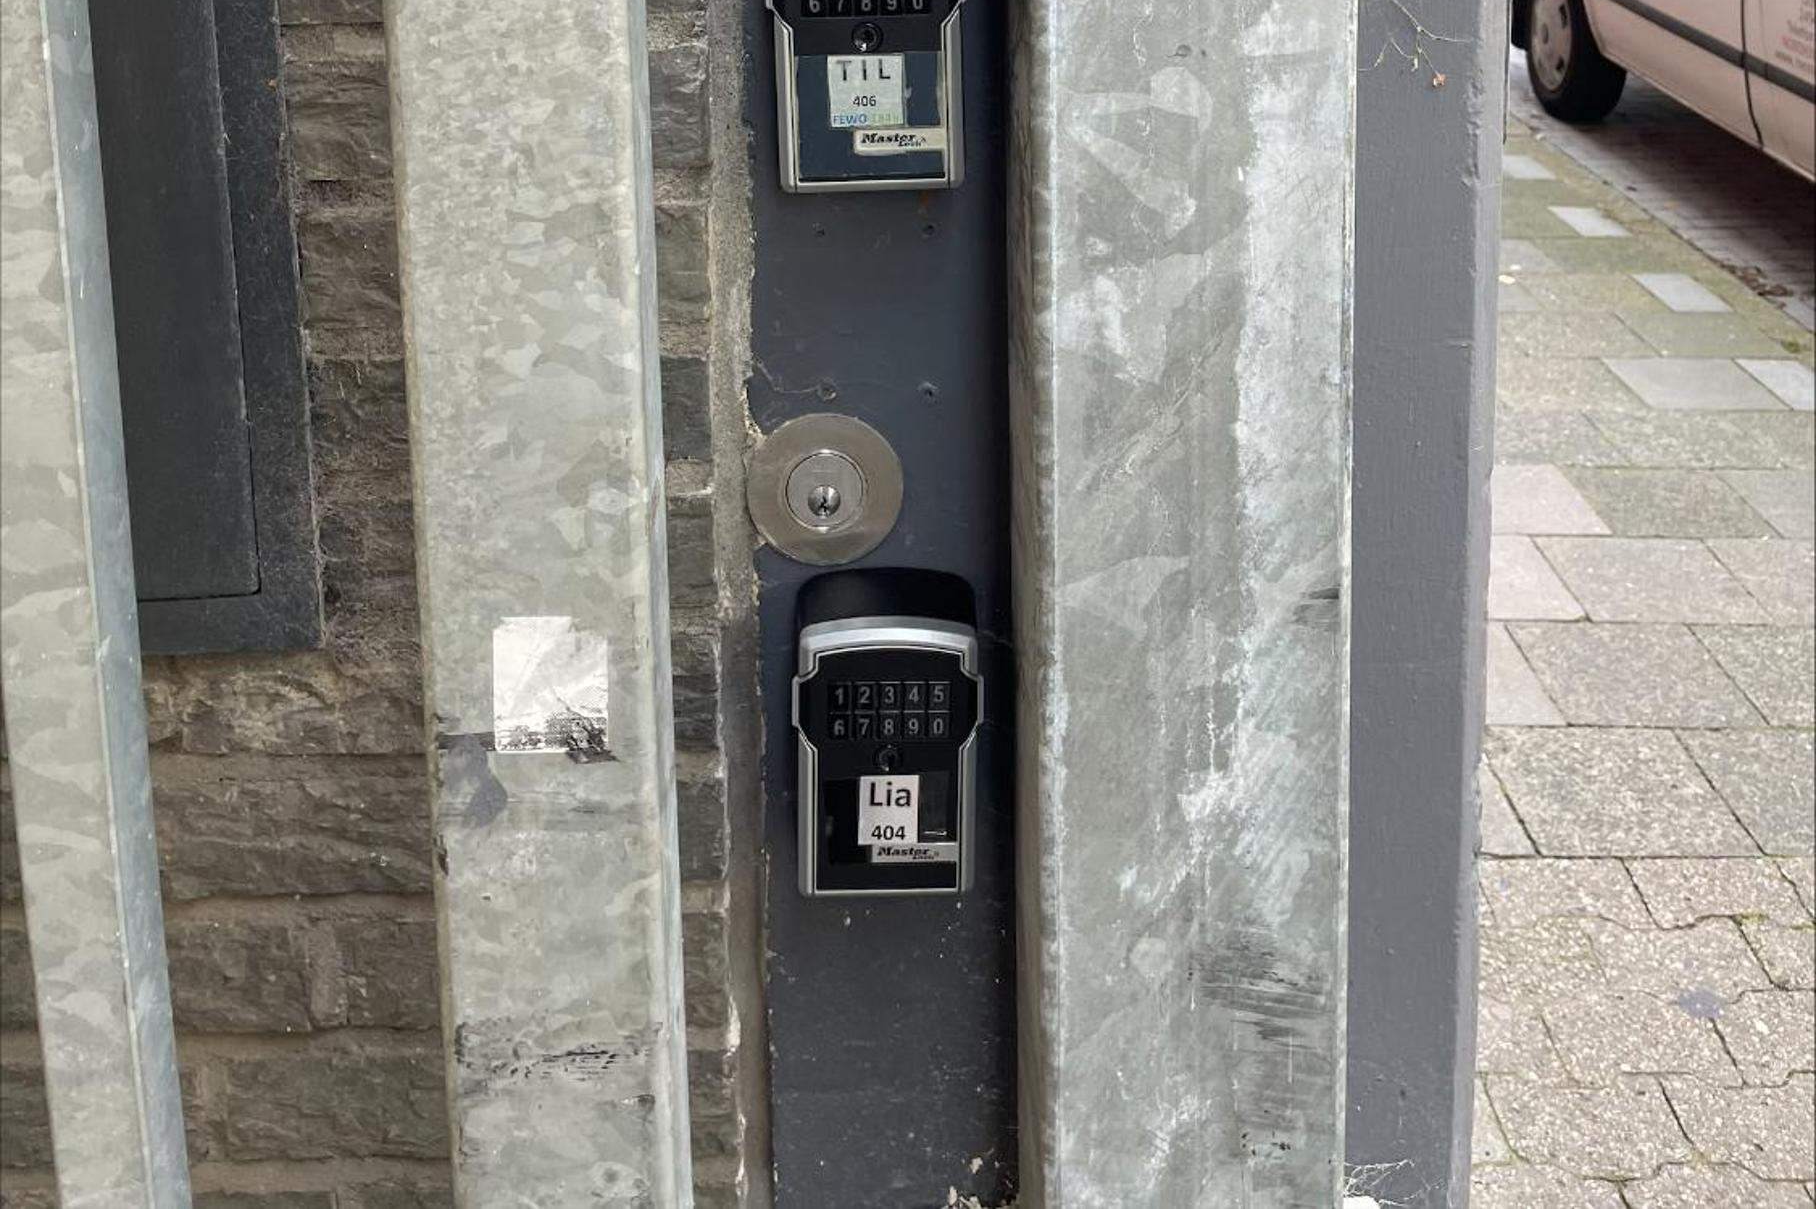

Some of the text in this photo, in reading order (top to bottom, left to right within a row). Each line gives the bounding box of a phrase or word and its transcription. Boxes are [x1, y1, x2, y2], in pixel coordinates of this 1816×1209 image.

[836, 58, 891, 81] TIL
[852, 95, 877, 107] 406
[861, 133, 916, 144] Master
[834, 685, 945, 705] 1 2 3 4 5
[834, 717, 944, 736] 6 7 8 9 0
[869, 781, 912, 808] Lia
[871, 824, 906, 841] 404
[877, 847, 929, 857] Master
